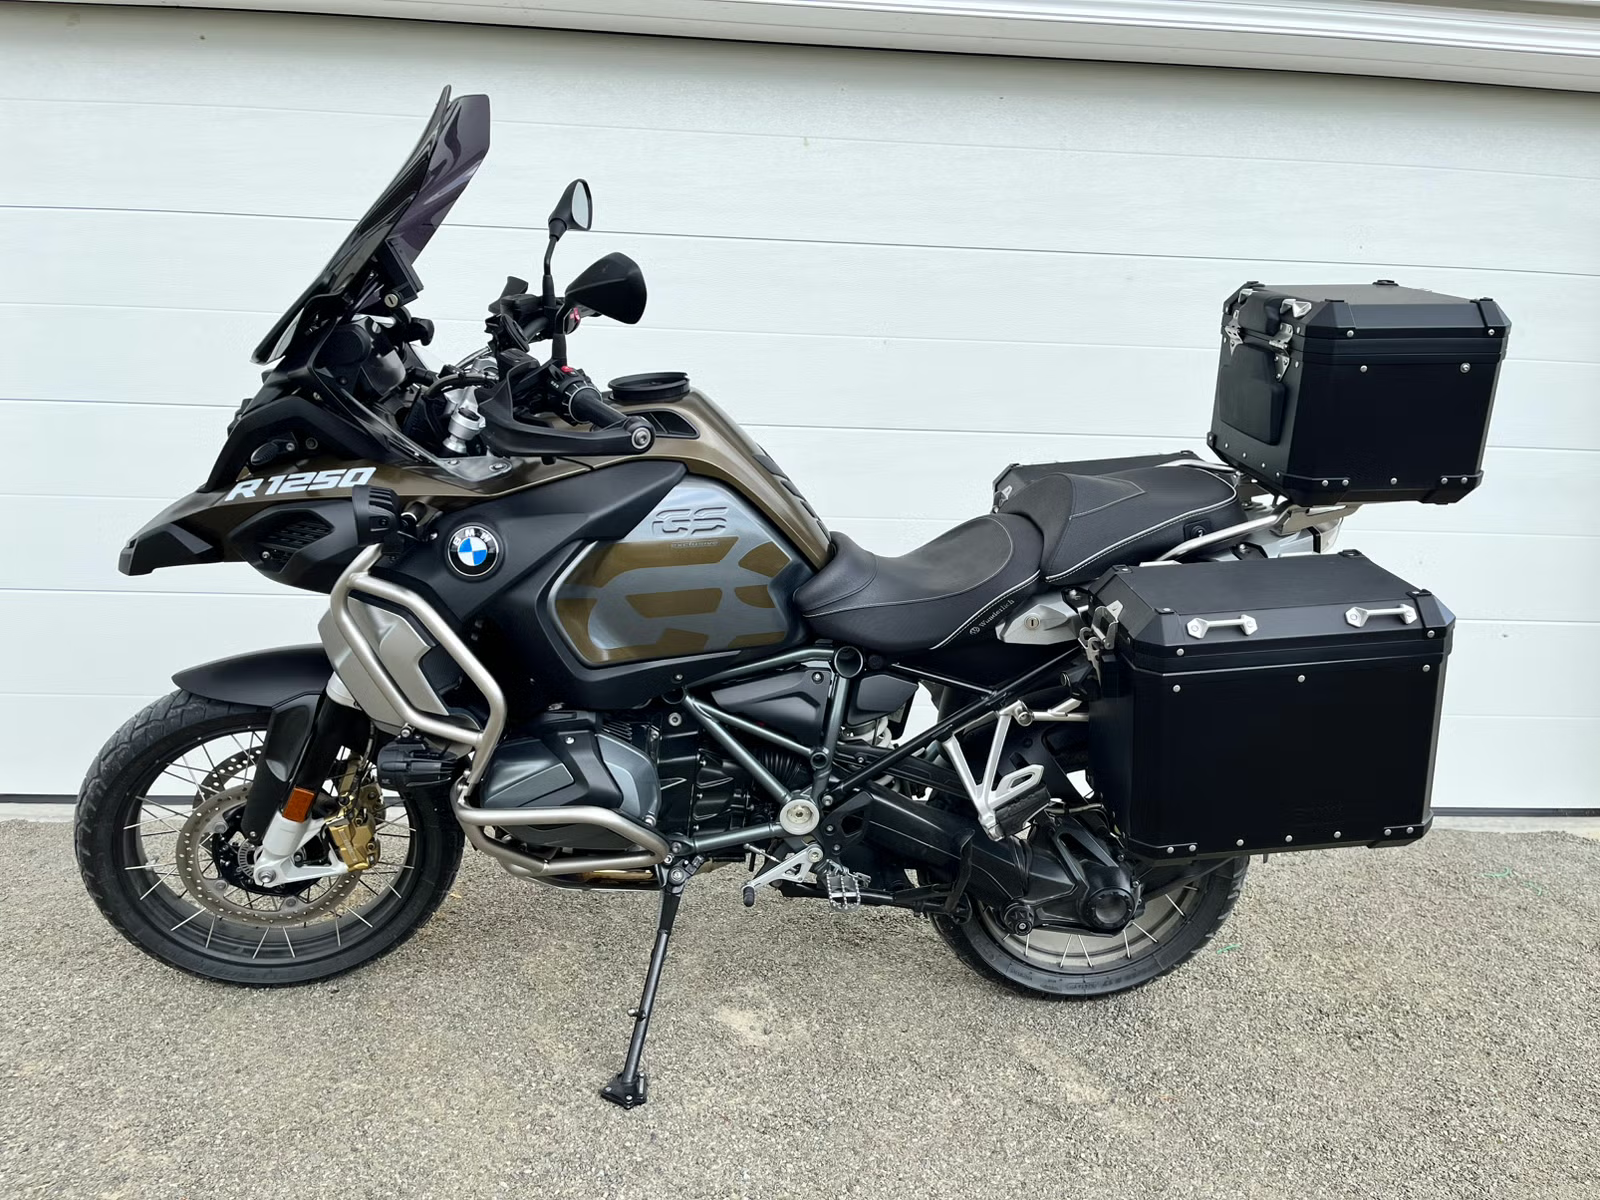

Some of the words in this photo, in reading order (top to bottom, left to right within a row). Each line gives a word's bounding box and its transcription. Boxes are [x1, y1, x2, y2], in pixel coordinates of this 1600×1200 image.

[224, 478, 264, 502] R
[264, 466, 377, 496] 1250
[452, 527, 492, 547] BMW
[652, 507, 728, 537] GS
